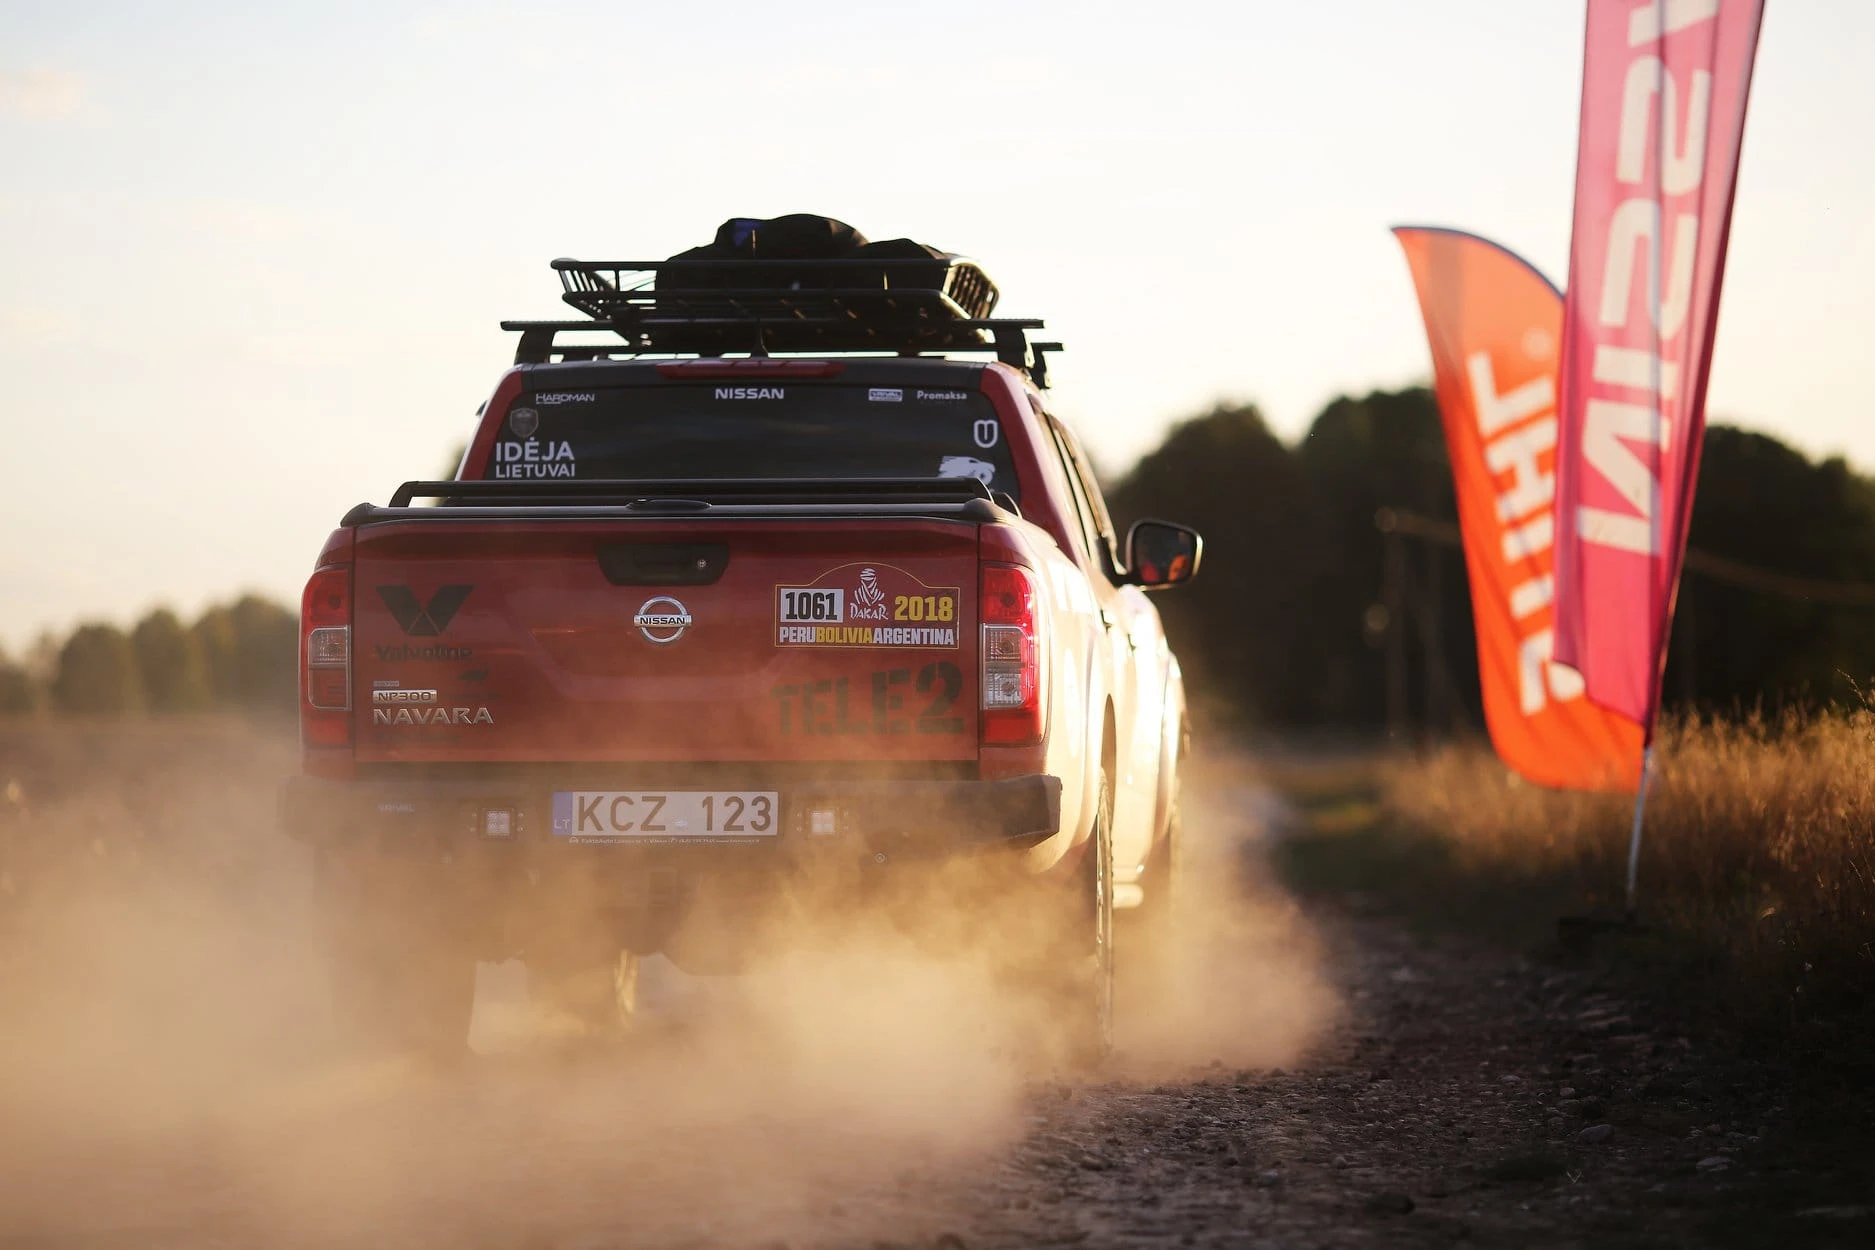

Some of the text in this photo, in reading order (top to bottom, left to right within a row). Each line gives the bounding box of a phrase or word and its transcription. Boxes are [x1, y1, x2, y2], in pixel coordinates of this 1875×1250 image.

[536, 393, 595, 402] HARDMAN
[715, 388, 784, 400] NISSAN
[916, 390, 967, 400] Promaksa
[496, 437, 575, 461] IDĖJA
[496, 463, 575, 478] LIETUVAI
[785, 592, 838, 621] 1061
[894, 595, 953, 621] 2018
[640, 617, 685, 625] NISSAN
[377, 692, 432, 701] NP300
[771, 661, 965, 736] TELE2
[373, 707, 494, 725] NAVARA
[577, 796, 772, 832] KCZ 123
[553, 819, 570, 829] LT
